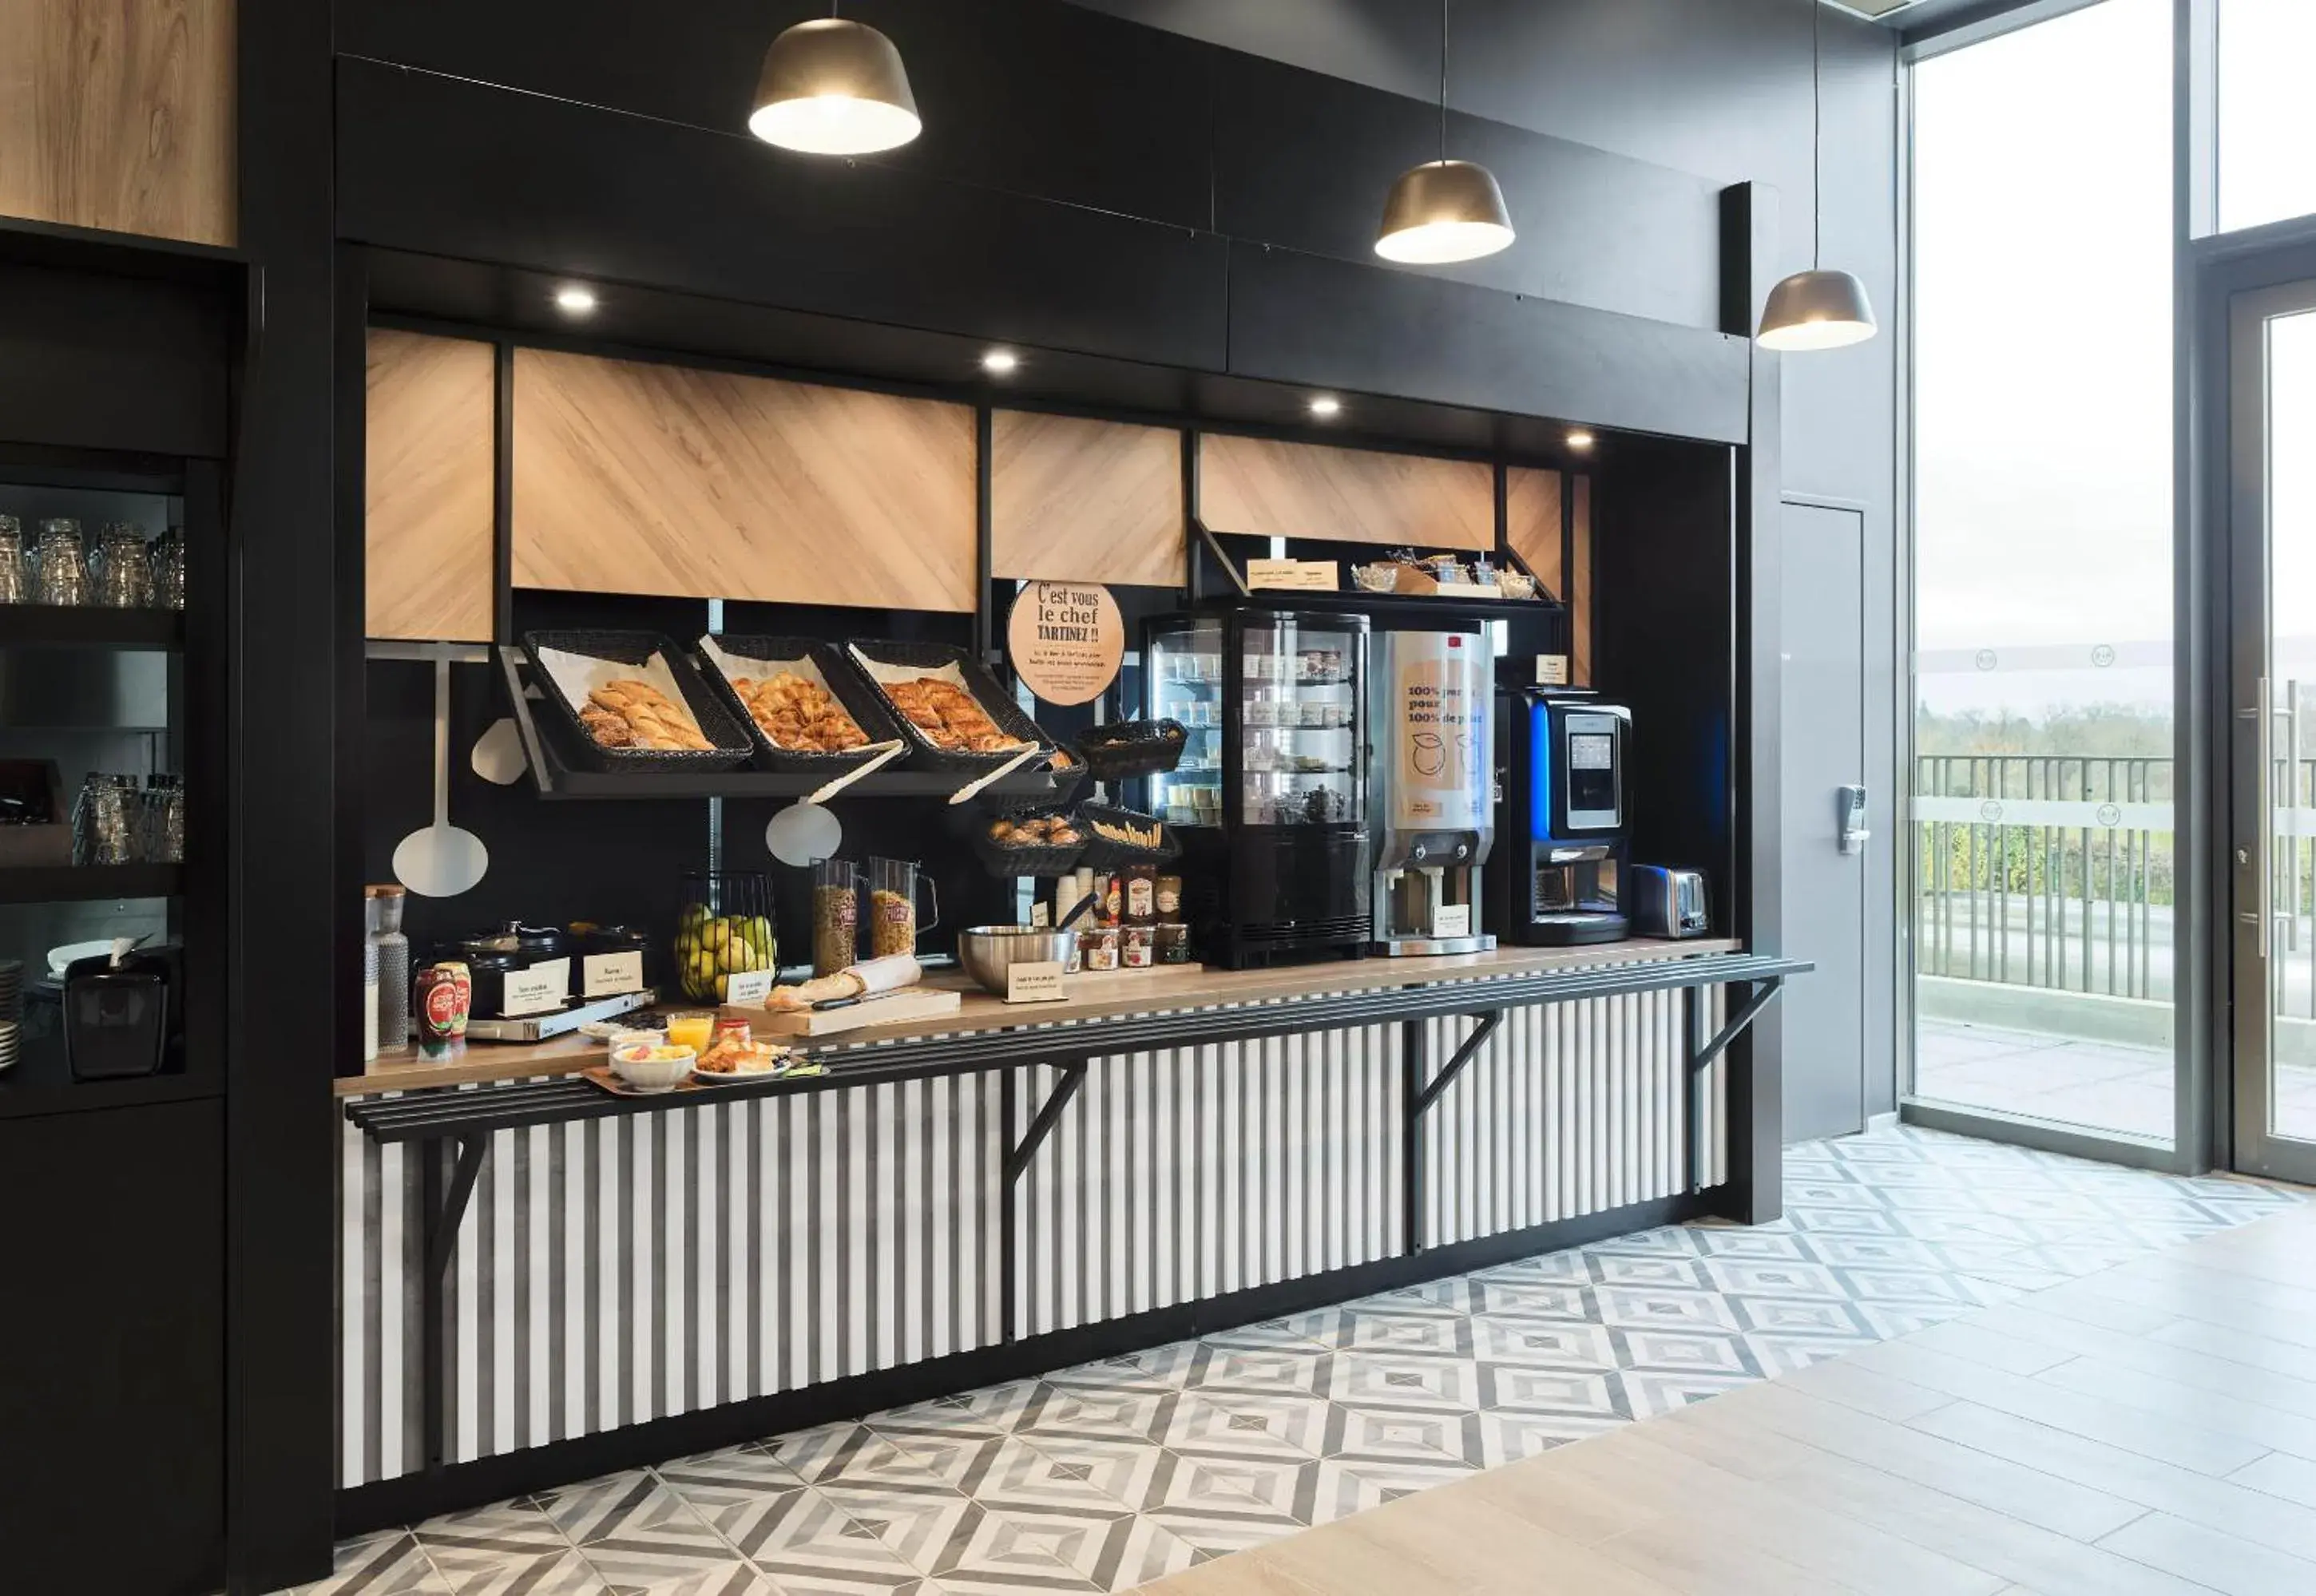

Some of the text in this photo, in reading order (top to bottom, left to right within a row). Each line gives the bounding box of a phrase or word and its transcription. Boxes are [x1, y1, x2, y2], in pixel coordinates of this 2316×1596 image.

[1038, 582, 1099, 607] C'est vous
[1038, 605, 1099, 624] le chef
[1037, 624, 1088, 642] TARTINEZ
[1409, 687, 1439, 695] 100%
[1409, 700, 1440, 711] pour
[1409, 713, 1439, 723] 100%
[1442, 713, 1456, 723] de
